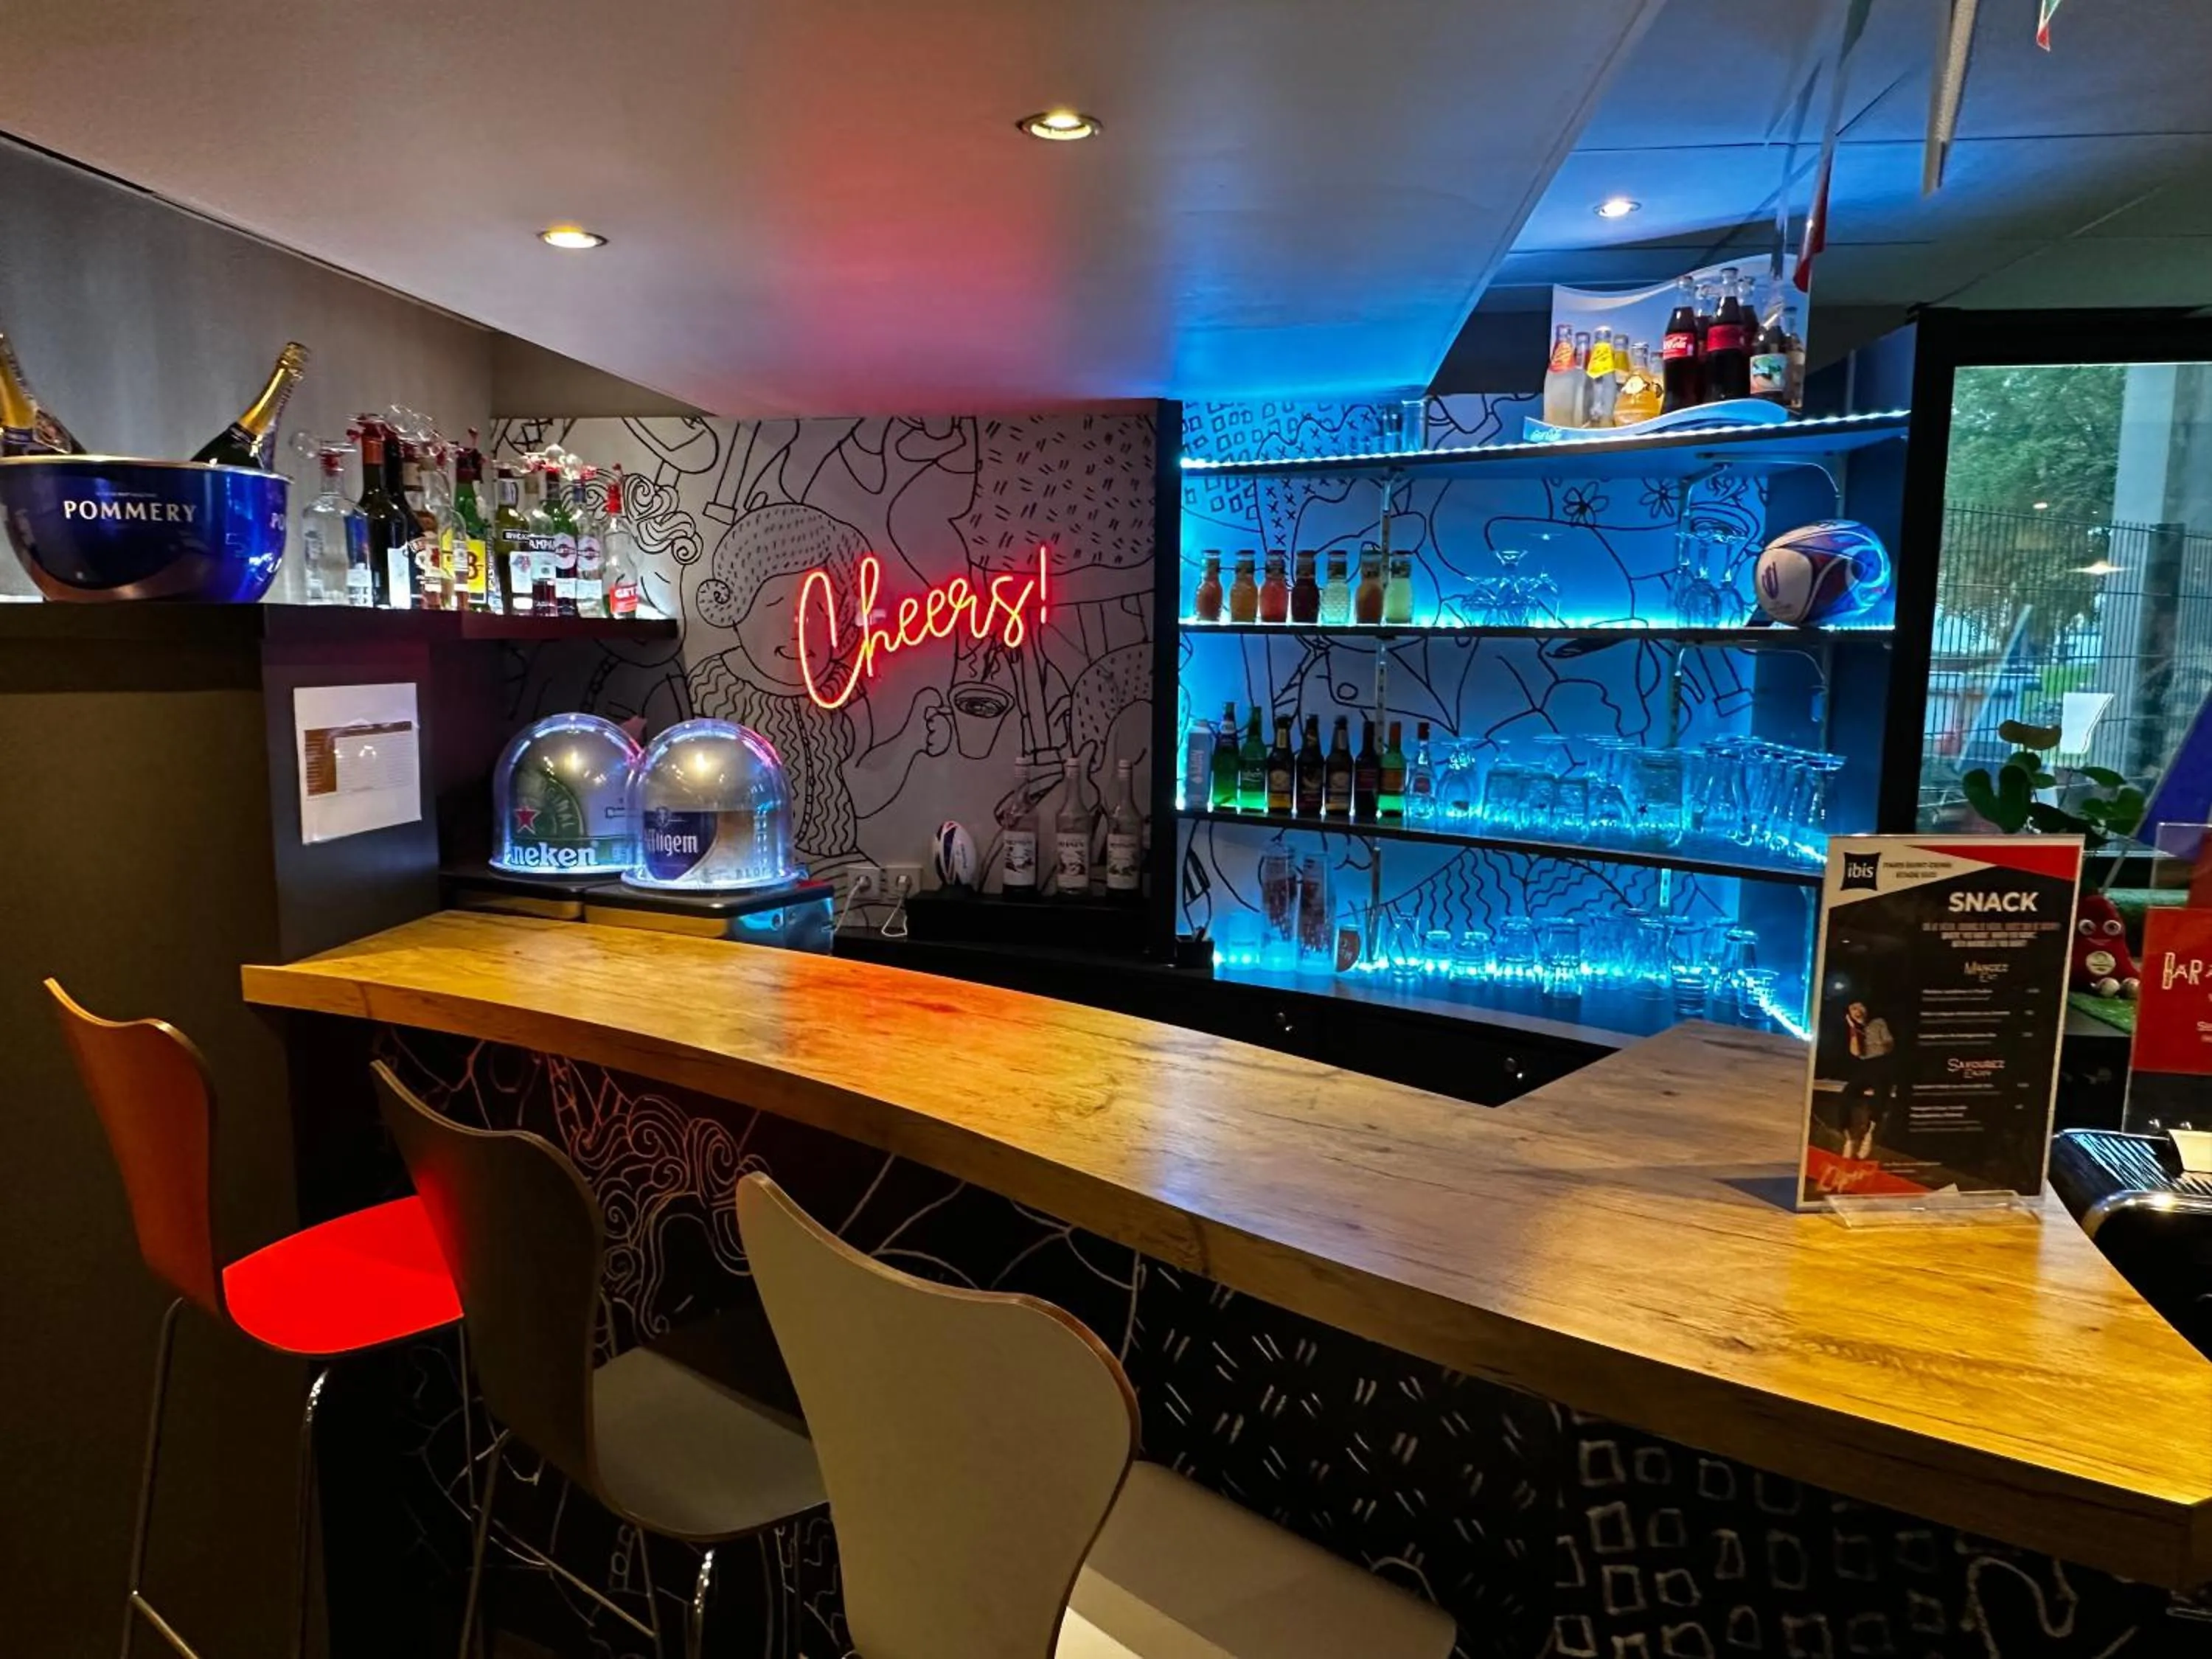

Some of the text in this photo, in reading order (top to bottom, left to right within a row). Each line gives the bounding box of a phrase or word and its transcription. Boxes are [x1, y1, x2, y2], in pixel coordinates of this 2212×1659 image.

[63, 500, 198, 524] POMMERY
[799, 546, 1047, 709] Cheers!
[1847, 863, 1874, 879] ibis
[1948, 891, 2039, 913] SNACK
